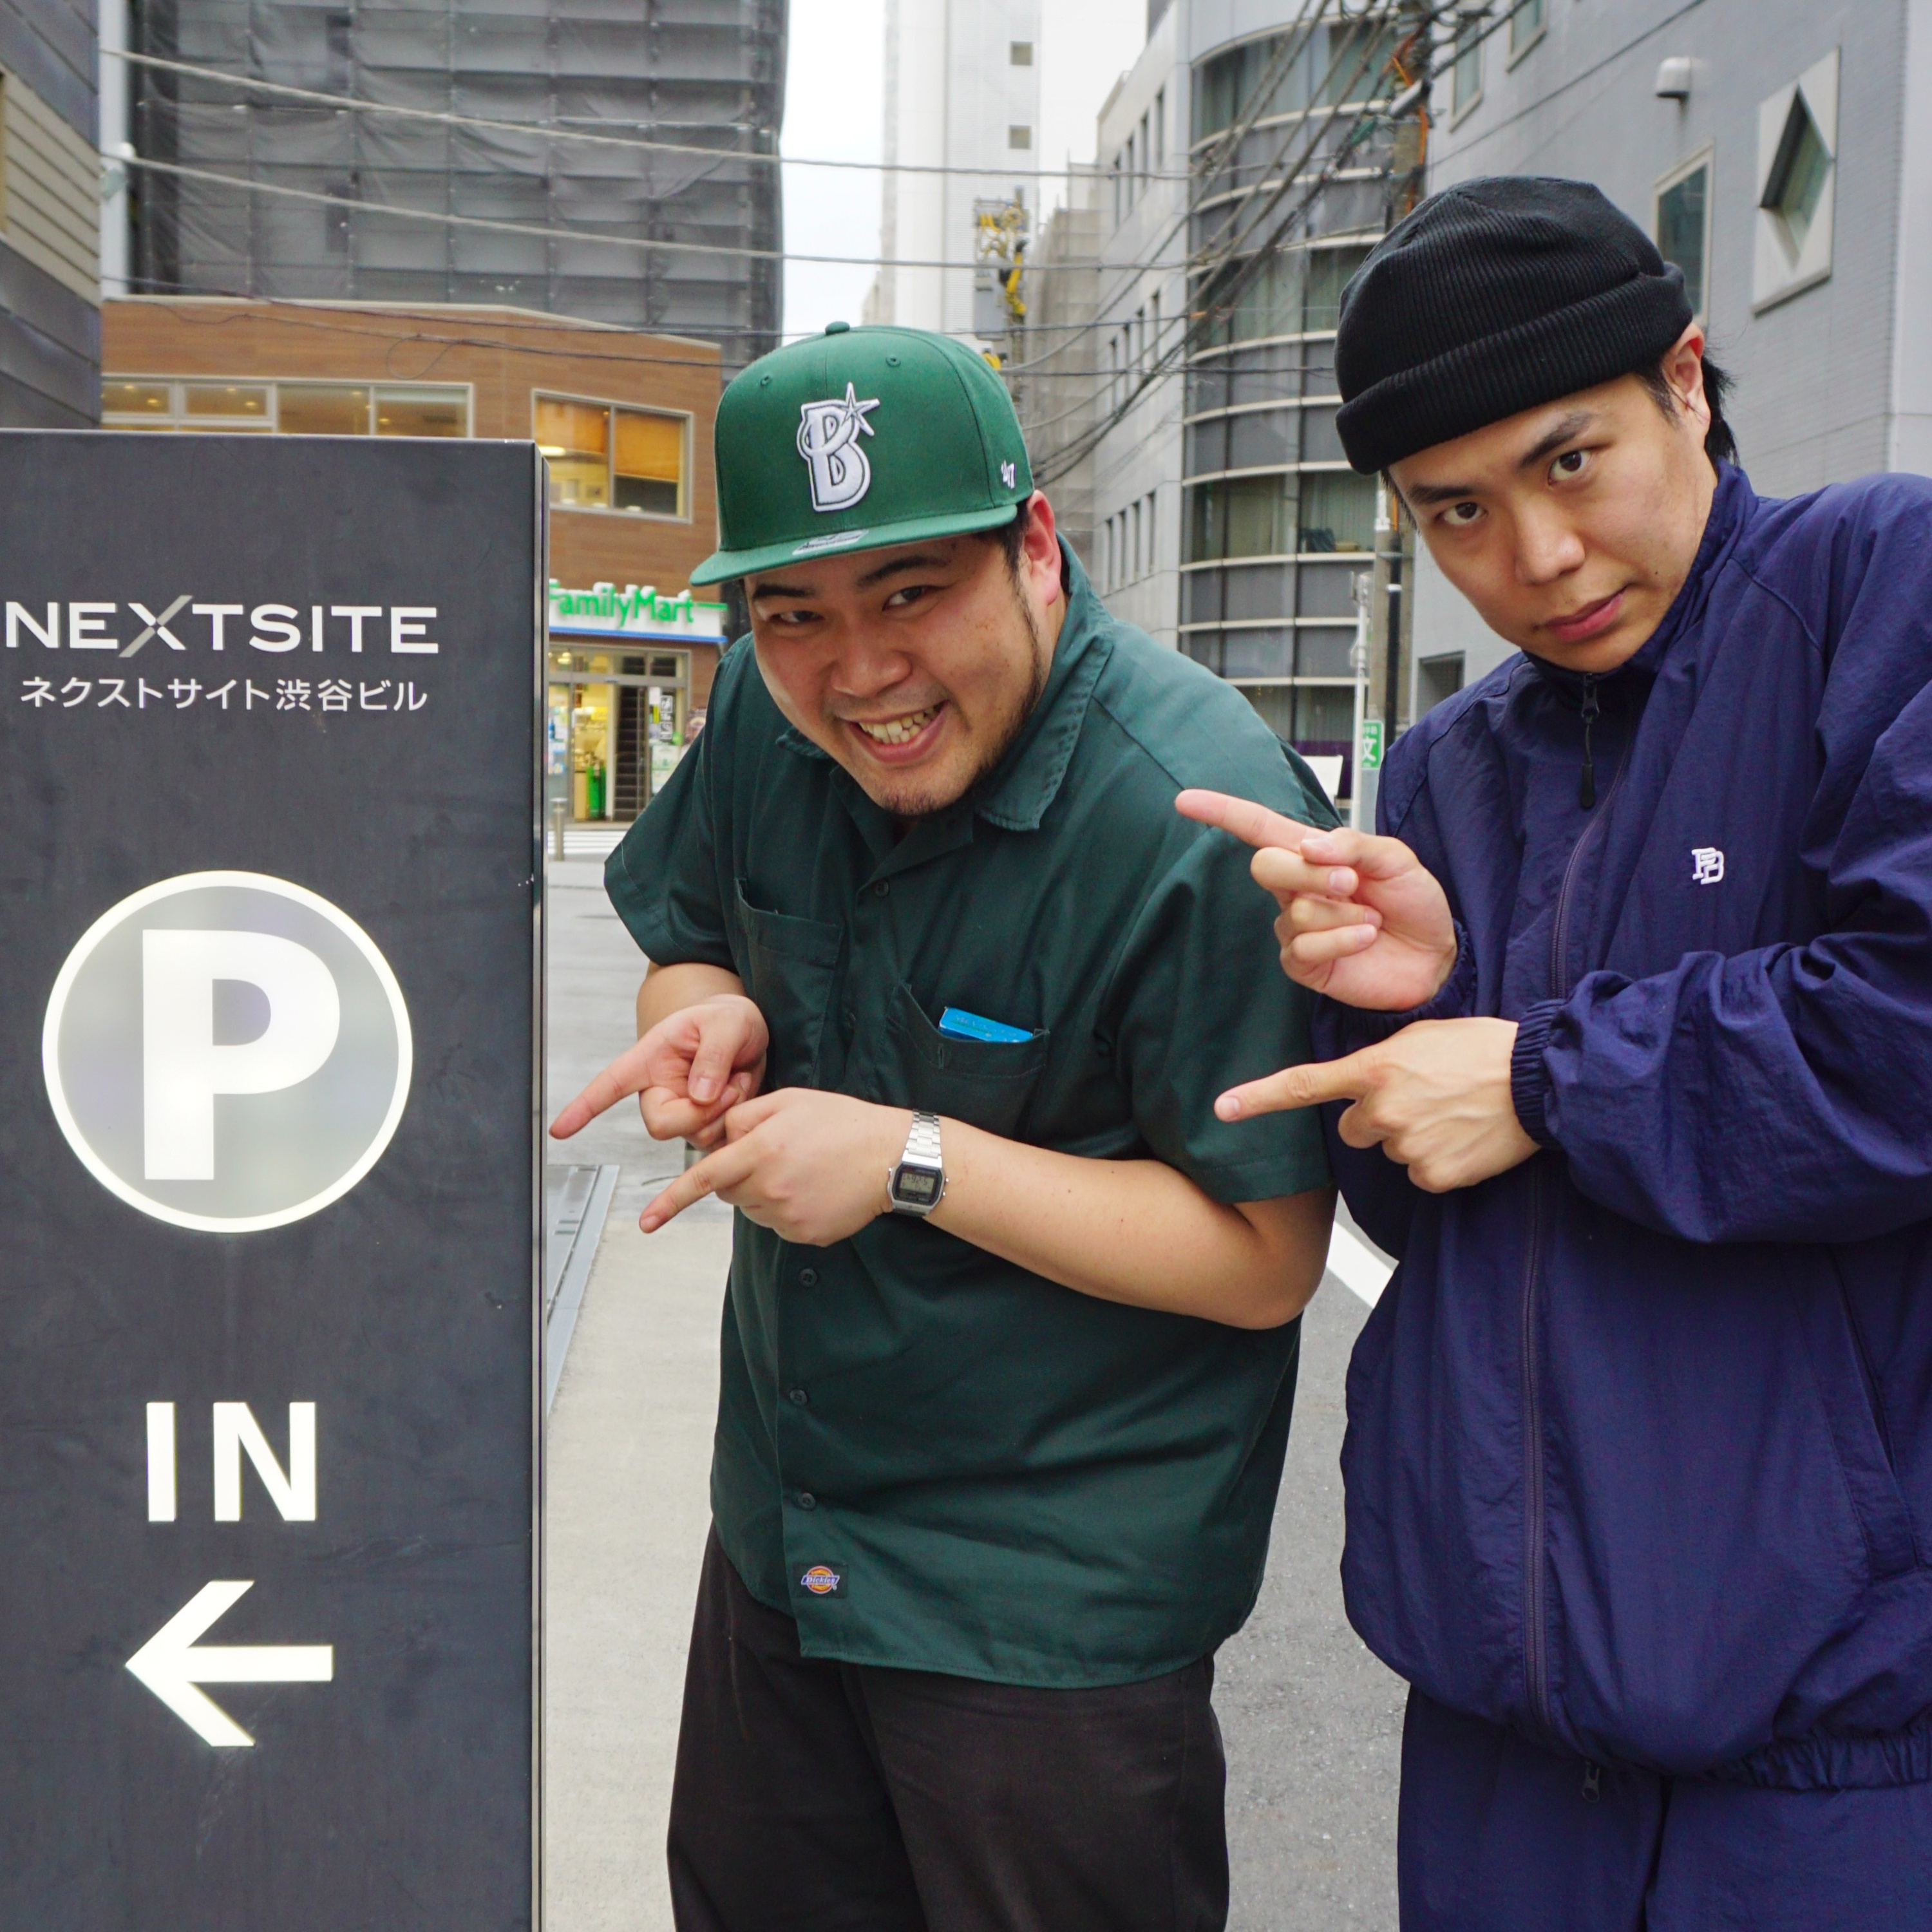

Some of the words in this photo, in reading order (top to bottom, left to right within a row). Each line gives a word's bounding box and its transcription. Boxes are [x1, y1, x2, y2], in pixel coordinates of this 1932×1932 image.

[5, 595, 439, 658] NEXTSITE
[21, 676, 428, 712] ネクストサイト渋谷ビル
[142, 929, 340, 1180] P
[146, 1402, 316, 1521] IN
[806, 1576, 836, 1584] Dickies
